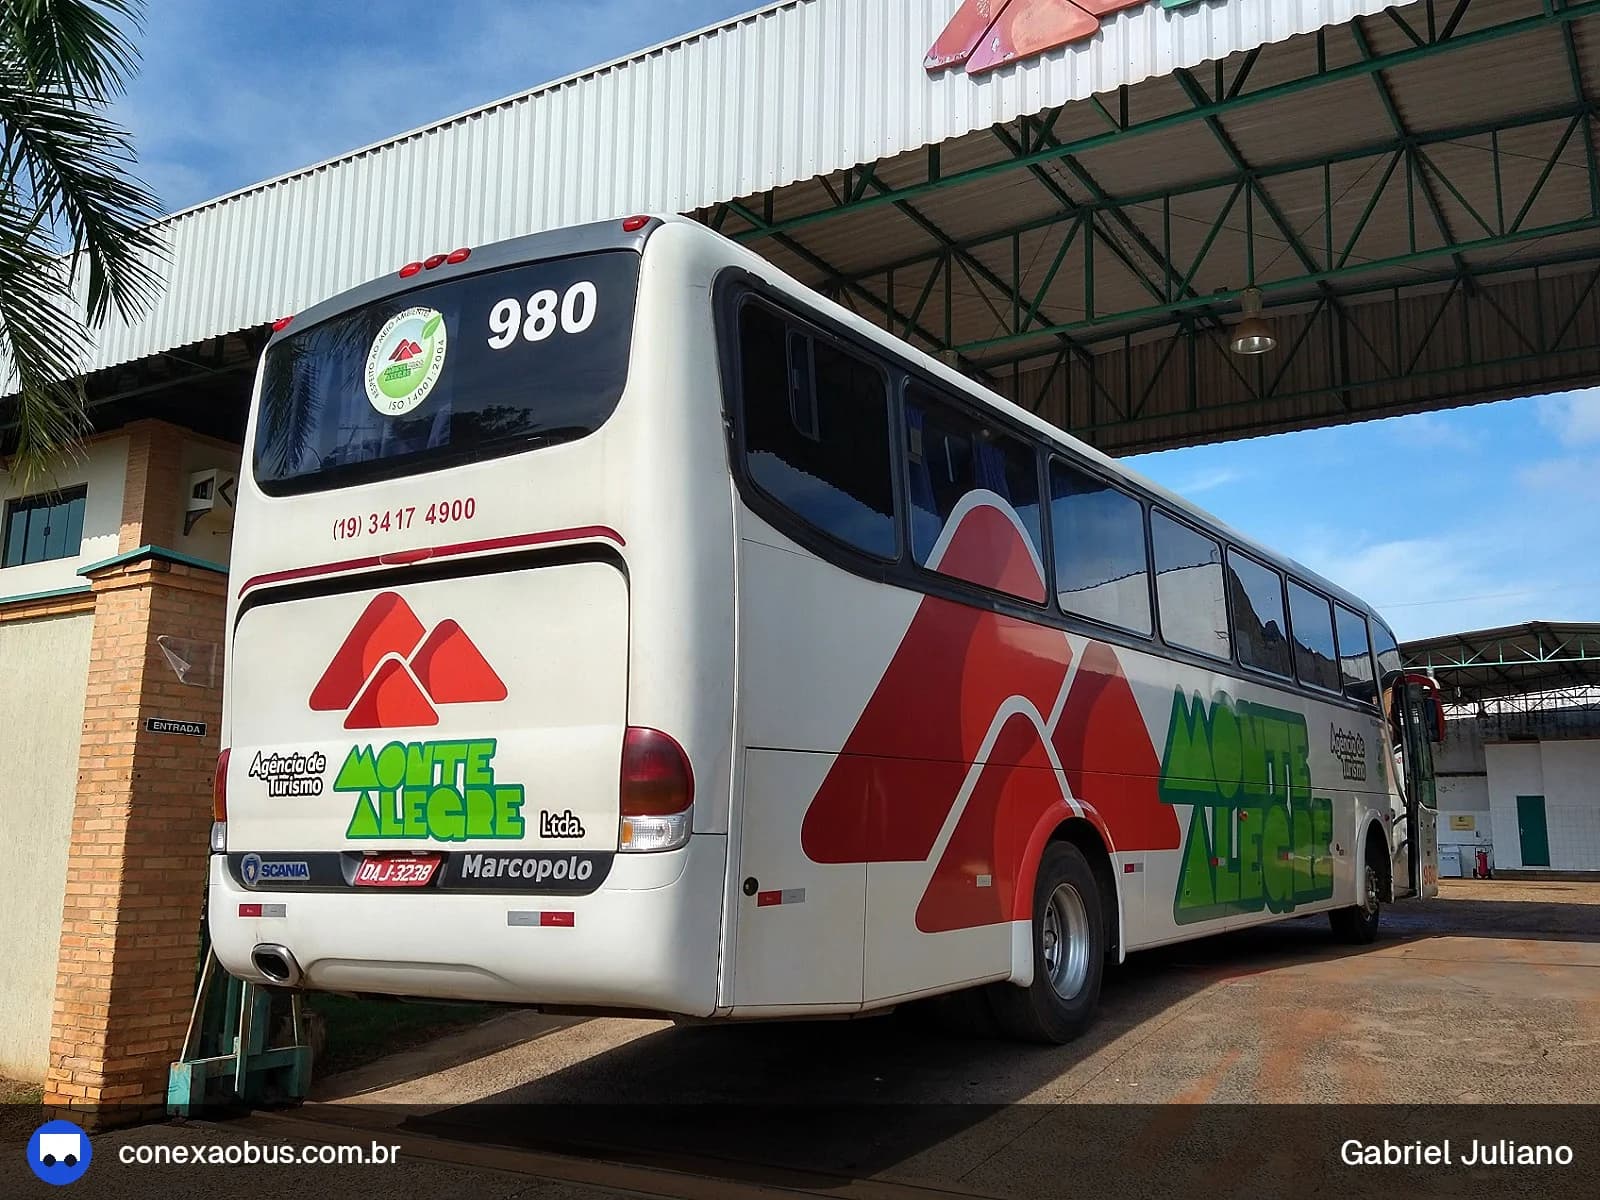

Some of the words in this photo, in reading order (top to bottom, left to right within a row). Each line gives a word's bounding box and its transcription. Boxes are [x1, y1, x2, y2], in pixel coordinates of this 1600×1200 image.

[487, 280, 598, 350] 980
[379, 321, 395, 343] MEIO
[388, 400, 405, 410] ISO
[333, 515, 361, 540] (19)
[368, 507, 416, 534] 3417
[425, 497, 476, 524] 4900
[153, 721, 201, 734] ENTRADA
[1160, 684, 1312, 808] MONTE
[248, 750, 306, 780] Agência
[305, 751, 326, 774] de
[334, 738, 498, 792] MONTE
[267, 774, 323, 797] Turismo
[346, 785, 525, 841] ALEGRE
[540, 810, 586, 838] Ltda.
[261, 864, 308, 877] SCANIA
[461, 853, 593, 882] Marcopolo
[1173, 798, 1335, 925] ALEGRE
